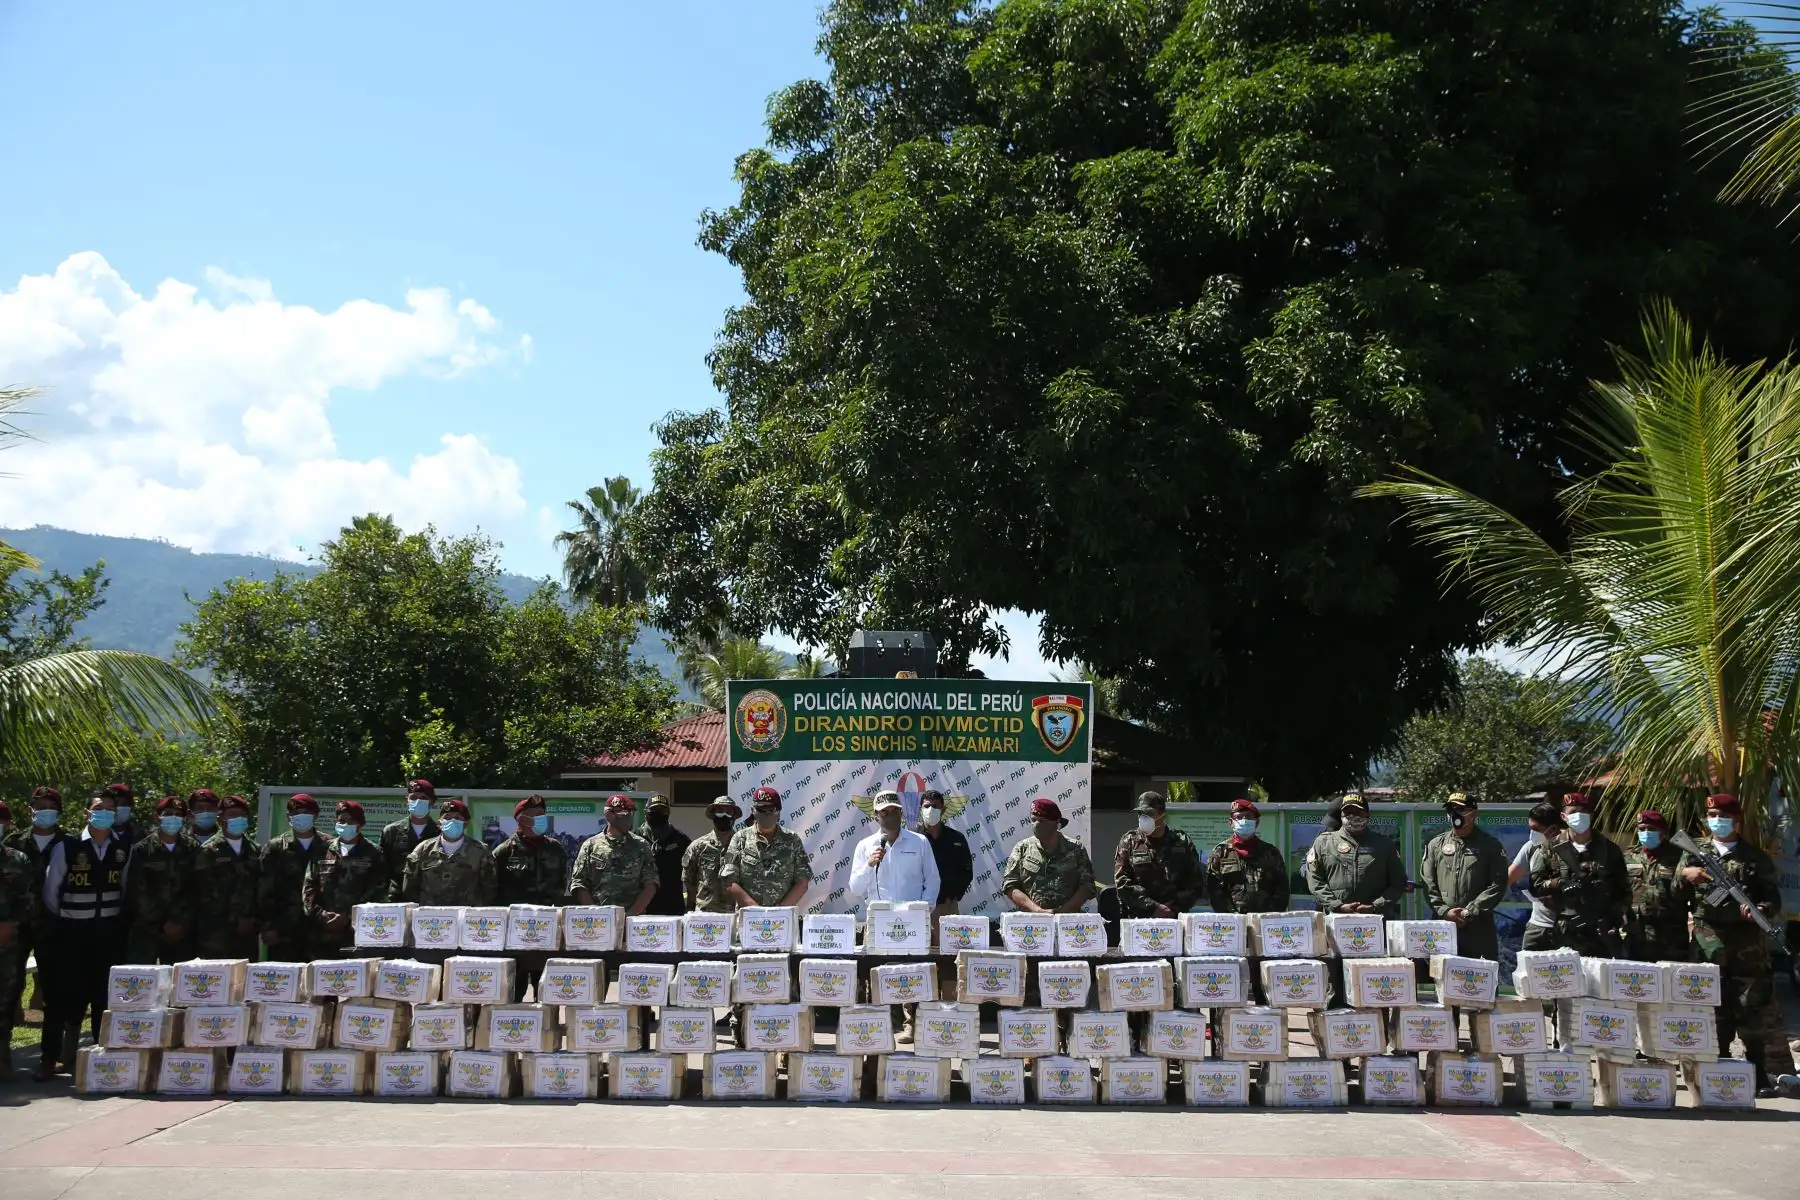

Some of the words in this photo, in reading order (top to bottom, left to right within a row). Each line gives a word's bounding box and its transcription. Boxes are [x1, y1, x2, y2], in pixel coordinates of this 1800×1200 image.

[794, 688, 858, 711] POLICÍA
[861, 692, 942, 711] NACIONAL
[946, 692, 976, 712] DEL
[982, 690, 1022, 712] PERÚ
[794, 715, 912, 732] DIRANDRO
[920, 716, 1024, 733] DIVMCTID
[812, 736, 846, 752] LOS
[850, 736, 916, 752] SINCHIS
[932, 736, 1018, 752] MAZAMARI
[781, 761, 797, 774] PNP
[816, 762, 832, 776] PNP
[851, 766, 866, 779] PNP
[941, 760, 957, 773] PNP
[976, 763, 991, 777] PNP
[761, 773, 776, 787] PNP
[886, 769, 902, 783] PNP
[1010, 767, 1026, 781] PNP
[1044, 772, 1059, 785] PNP
[796, 776, 811, 790] PNP
[831, 779, 846, 793] PNP
[866, 782, 882, 796] PNP
[956, 776, 972, 790] PNP
[990, 780, 1006, 794] PNP
[741, 787, 756, 801] PNP
[780, 790, 791, 801] NP
[1025, 784, 1039, 798] PNP
[1057, 789, 1072, 802] PNP
[810, 793, 826, 807] PNP
[970, 793, 986, 807] PNP
[1005, 797, 1020, 811] PNP
[790, 806, 806, 820] PNP
[825, 809, 841, 823] PNP
[985, 810, 1000, 824] PNP
[1072, 806, 1086, 819] PNP
[1020, 817, 1032, 828] PN
[804, 823, 820, 837] PNP
[840, 826, 856, 840] PNP
[966, 823, 981, 837] PNP
[1000, 826, 1015, 840] PNP
[819, 840, 835, 854] PNP
[980, 840, 996, 854] PNP
[835, 856, 851, 871] PNP
[68, 872, 92, 886] POL
[814, 870, 830, 885] PNP
[977, 870, 992, 884] PNP
[829, 888, 845, 902] PNP
[808, 901, 824, 914] PNP
[972, 900, 988, 914] PNP
